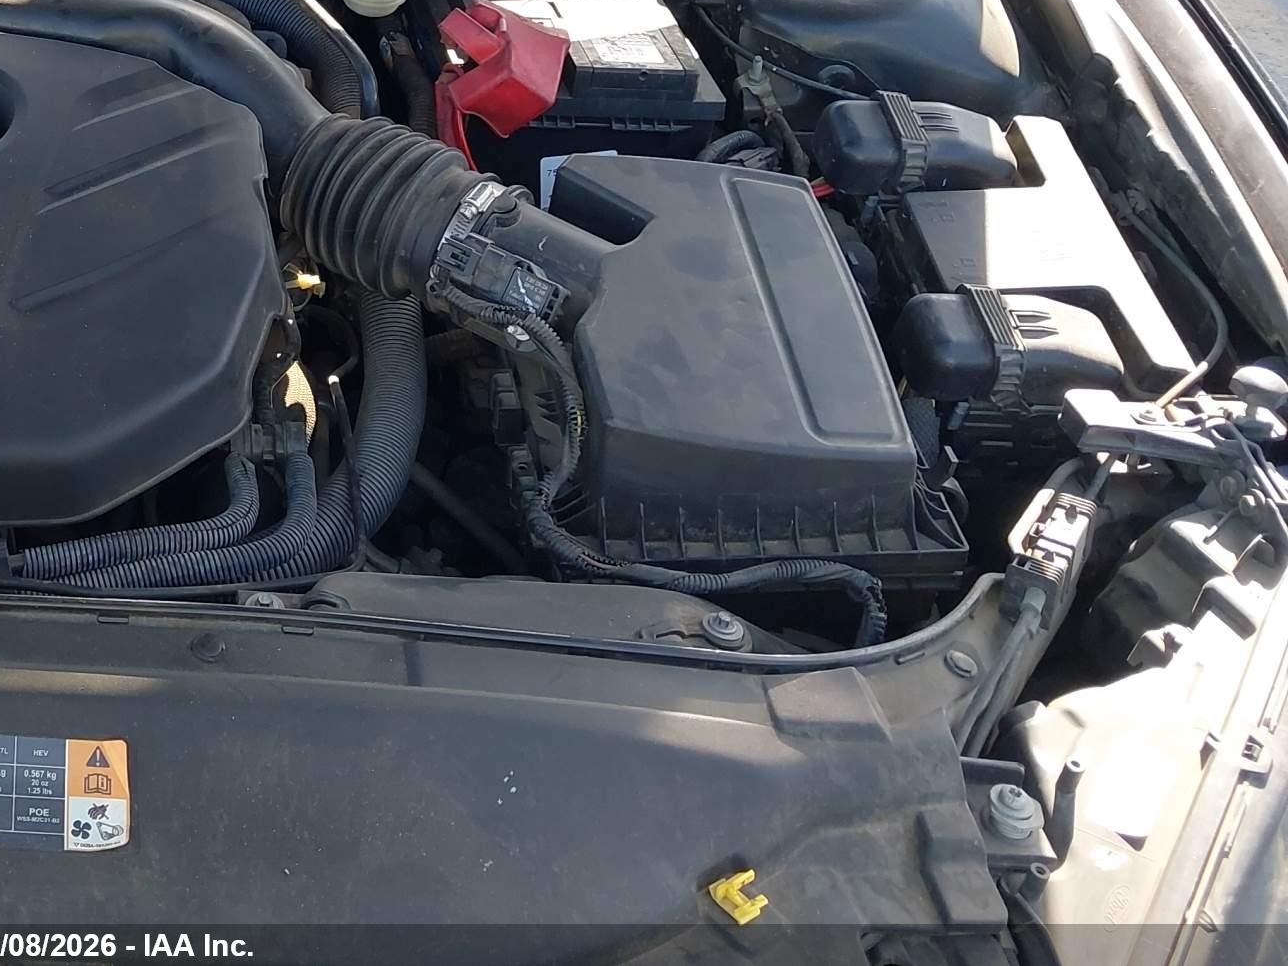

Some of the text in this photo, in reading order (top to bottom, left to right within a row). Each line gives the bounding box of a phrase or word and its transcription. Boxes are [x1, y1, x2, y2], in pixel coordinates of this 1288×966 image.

[33, 749, 49, 757] HEV
[23, 769, 57, 781] 0.567 kg
[27, 787, 41, 795] 1.25
[28, 807, 51, 817] POE
